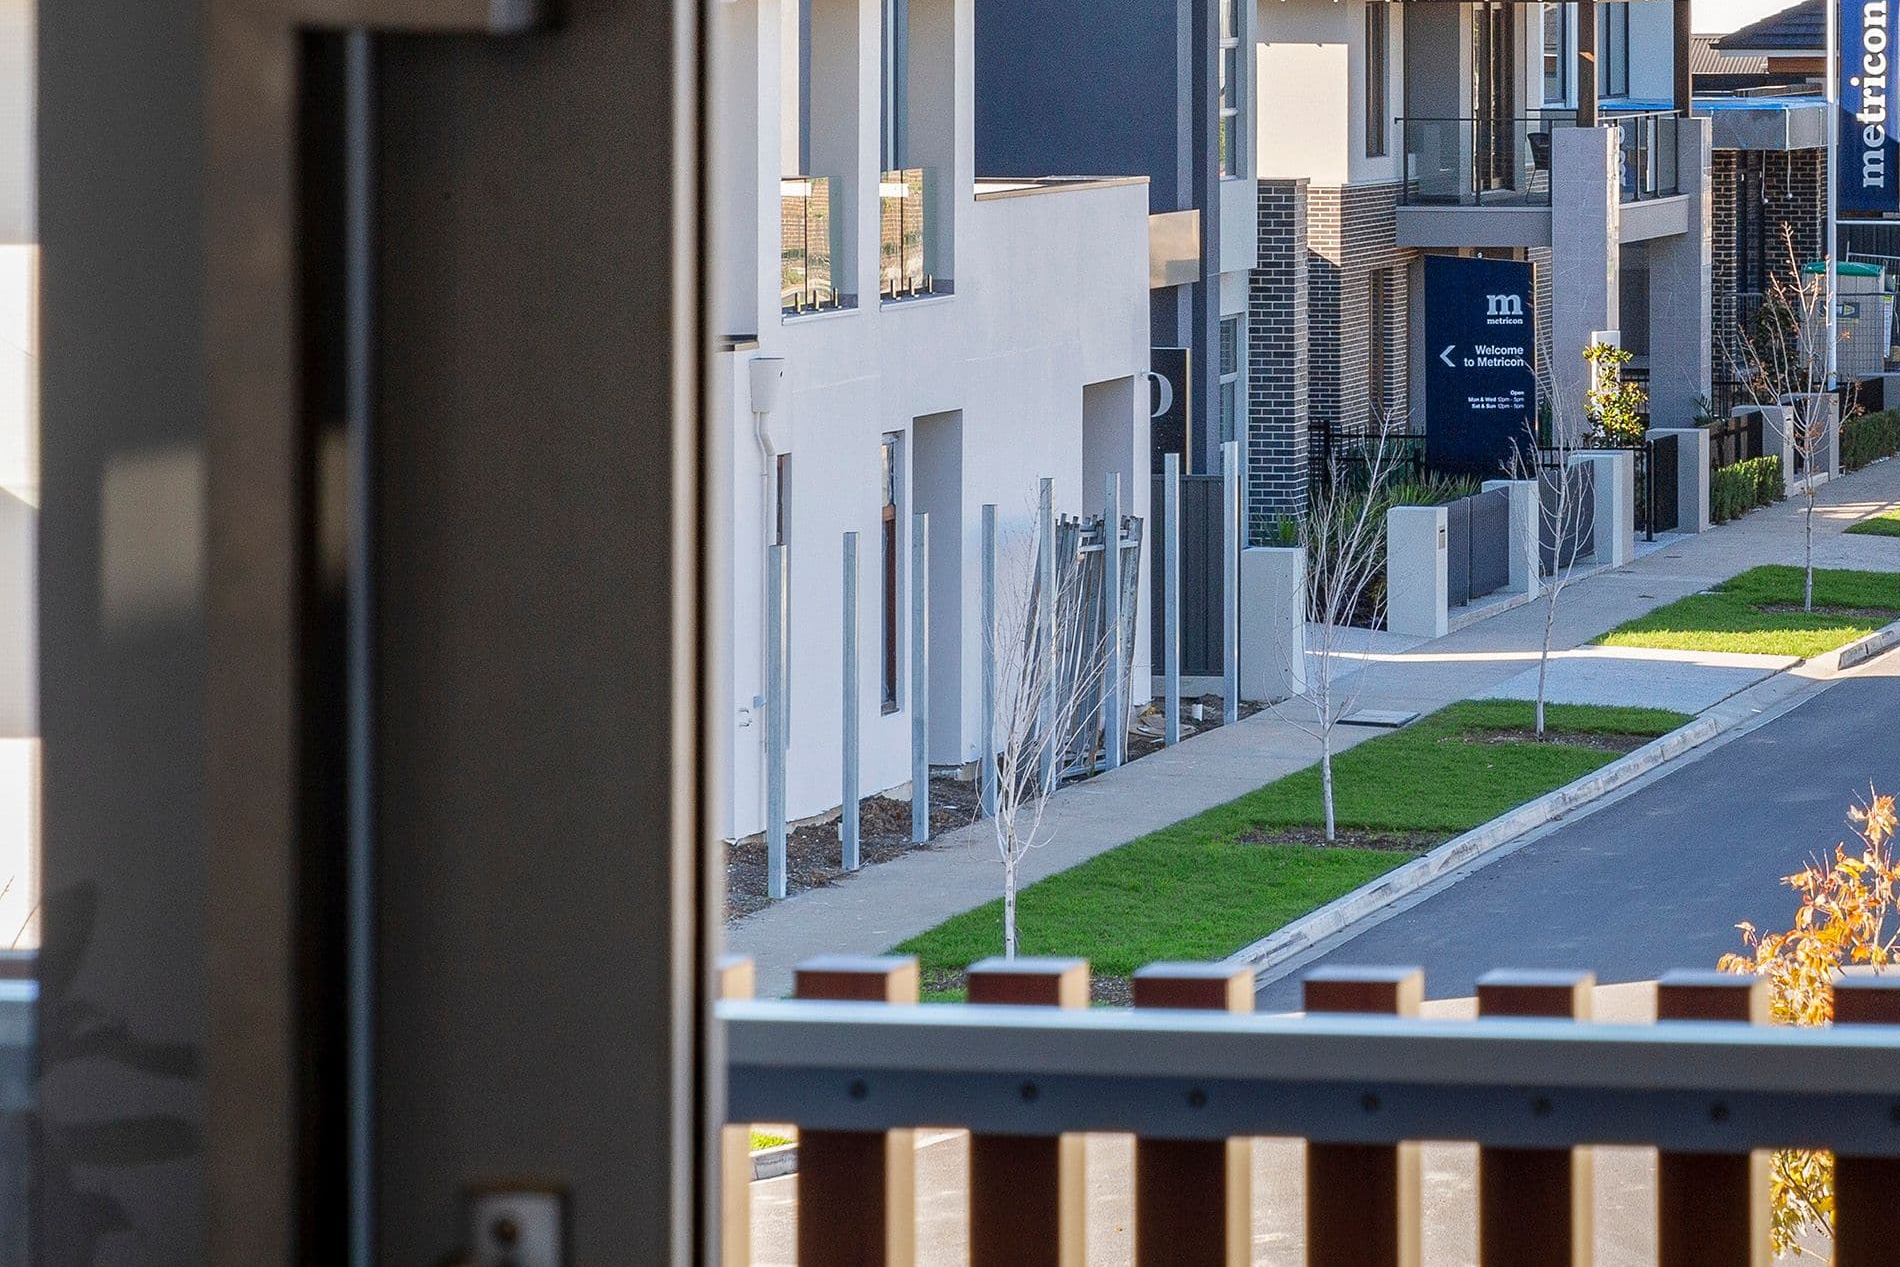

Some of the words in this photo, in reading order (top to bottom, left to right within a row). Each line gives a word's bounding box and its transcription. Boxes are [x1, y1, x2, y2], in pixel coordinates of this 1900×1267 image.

[1850, 0, 1887, 188] metricon
[1486, 294, 1523, 315] m
[1487, 317, 1523, 325] metricon
[1475, 345, 1524, 355] Welcome
[1464, 358, 1475, 367] to
[1477, 357, 1524, 367] Metricon
